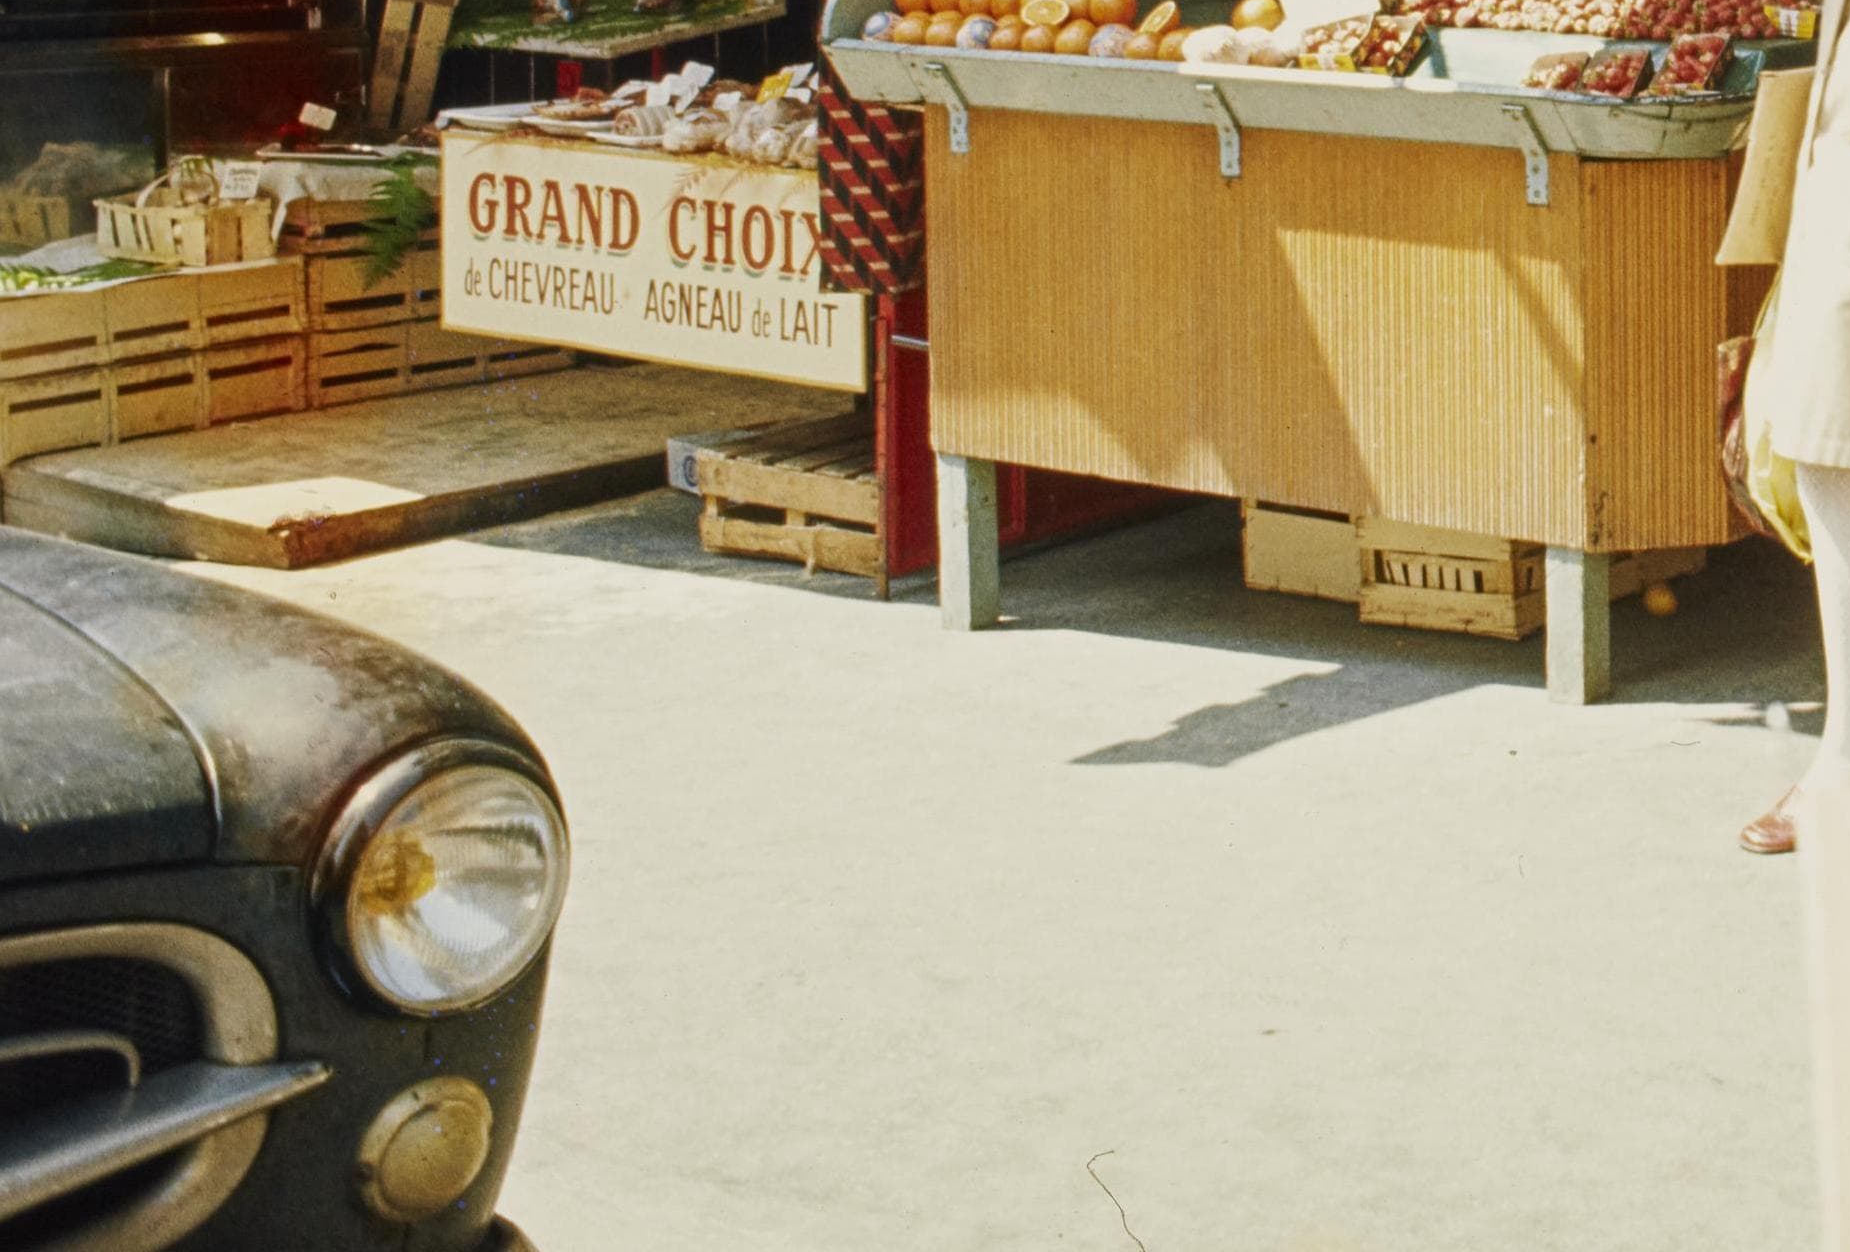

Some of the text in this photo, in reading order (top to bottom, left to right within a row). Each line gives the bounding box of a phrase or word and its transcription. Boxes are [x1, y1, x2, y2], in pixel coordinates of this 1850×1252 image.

[467, 170, 822, 280] GRAND CHOIX
[464, 256, 839, 348] de CHEVREAU AGNEAU de LAIT
